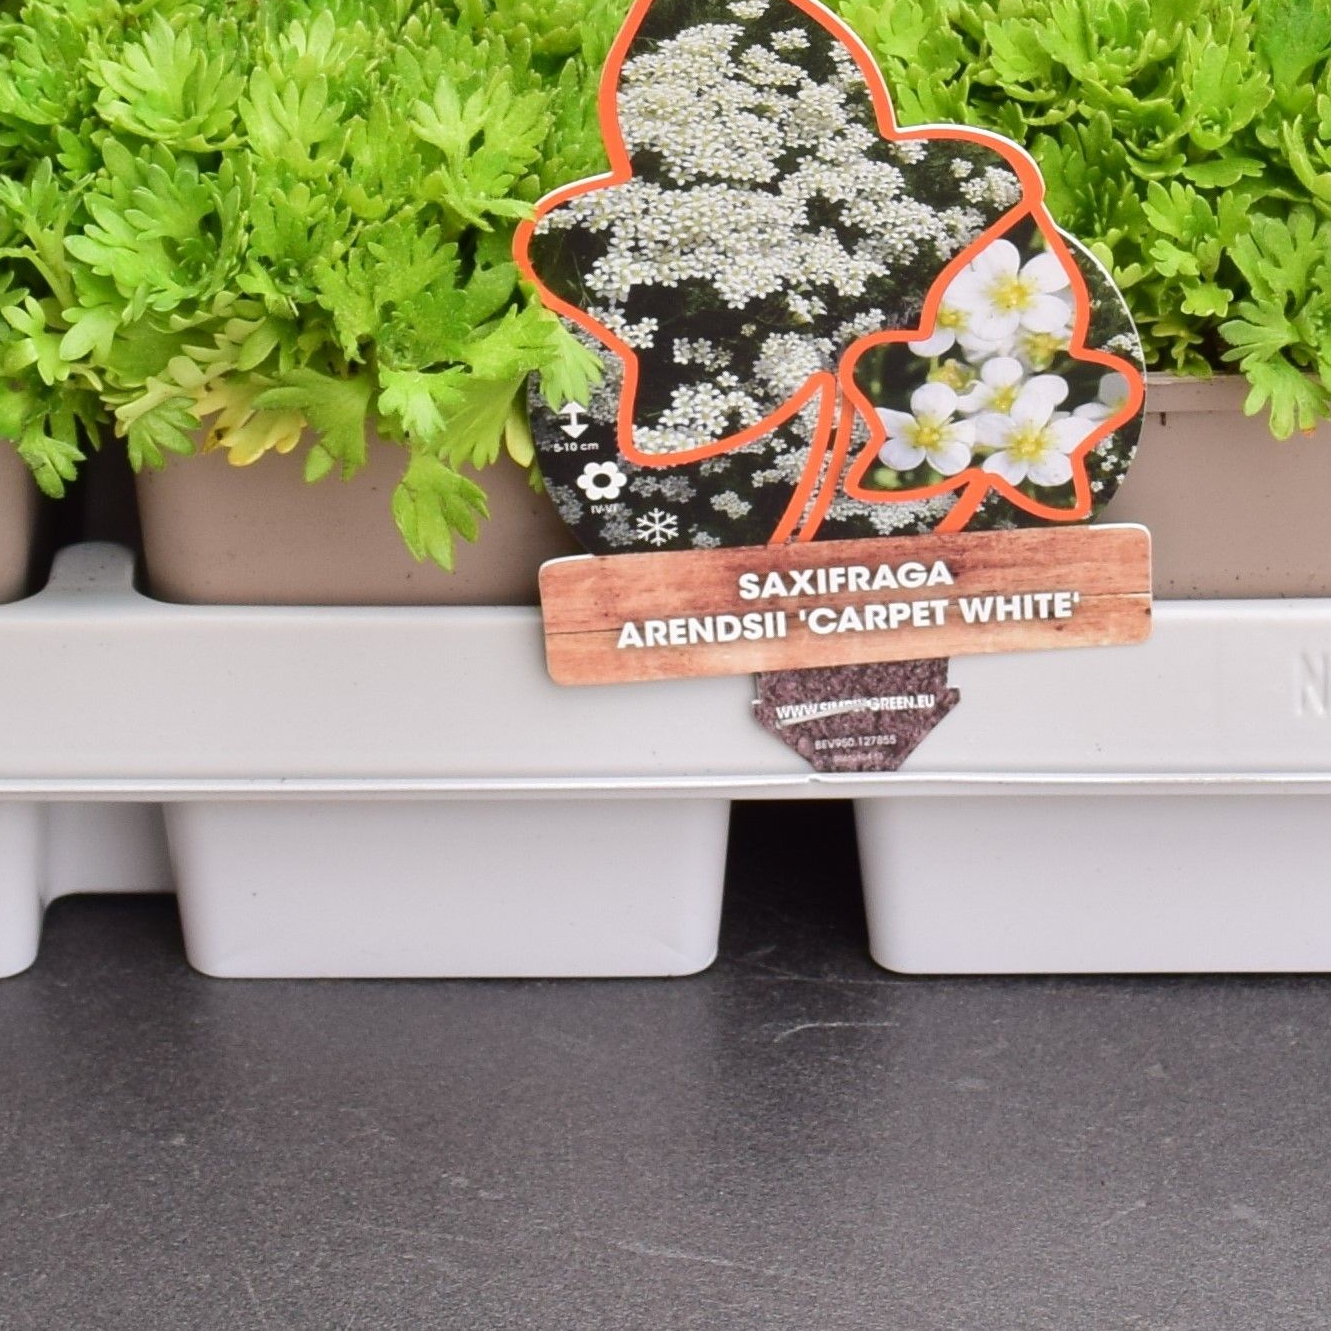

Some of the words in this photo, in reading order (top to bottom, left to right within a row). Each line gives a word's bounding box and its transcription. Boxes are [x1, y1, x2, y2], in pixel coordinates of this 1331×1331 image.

[580, 442, 599, 451] cm
[738, 560, 954, 600] SAXIFRAGA
[616, 611, 787, 649] ARENDSII
[799, 599, 949, 636] 'CARPET
[958, 591, 1081, 624] WHITE'
